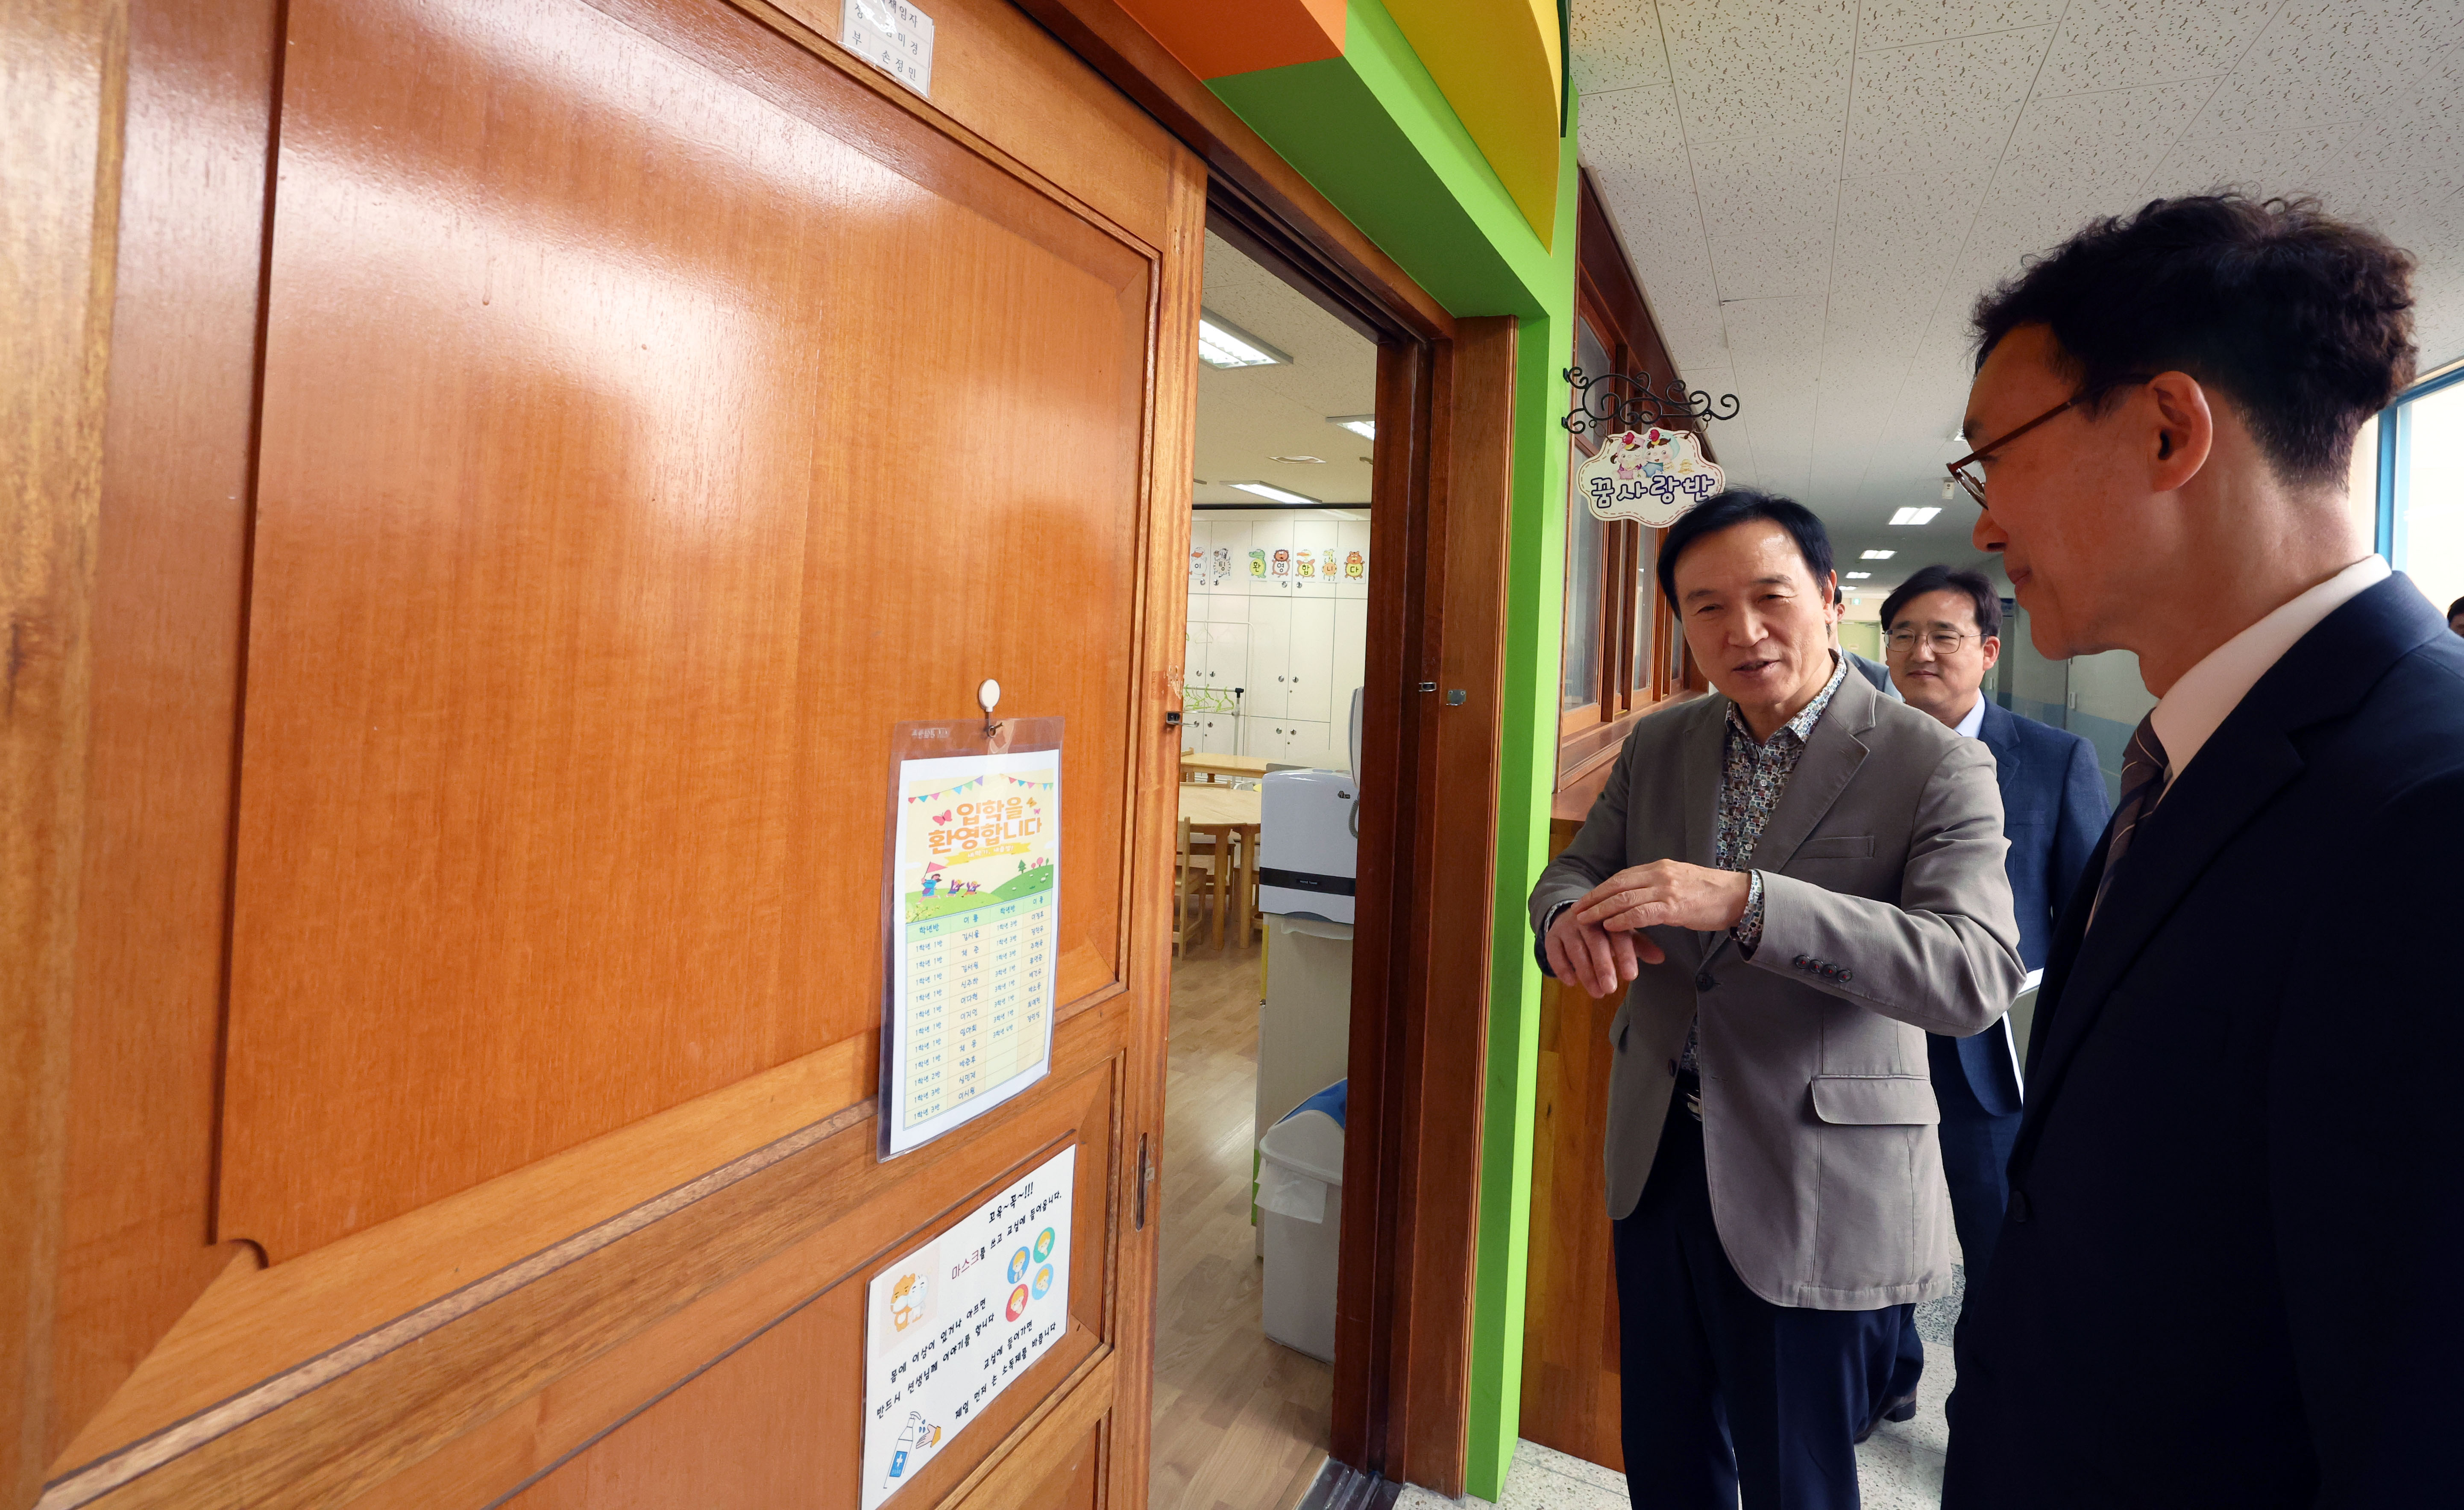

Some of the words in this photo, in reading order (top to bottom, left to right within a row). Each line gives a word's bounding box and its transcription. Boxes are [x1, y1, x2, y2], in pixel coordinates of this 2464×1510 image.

[852, 30, 862, 45] 부
[957, 796, 1023, 826] 입학을
[928, 817, 1042, 855] 환영합니다
[919, 923, 939, 934] 학년반
[1000, 905, 1015, 914] 학년반
[916, 942, 930, 952] 1학년
[934, 940, 943, 948] 1반
[916, 959, 930, 969] 1학년
[934, 956, 943, 964] 1반
[916, 975, 930, 985] 1학년
[934, 972, 942, 981] 1반
[916, 992, 930, 1002] 1학년
[916, 1008, 930, 1018] 1학년
[915, 1026, 930, 1036] 1학년
[915, 1043, 930, 1052] 1학년
[915, 1059, 929, 1069] 1학년
[933, 1055, 941, 1063] 1반
[915, 1076, 929, 1086] 1학년
[932, 1071, 940, 1079] 2반
[914, 1092, 929, 1103] 1학년
[931, 1087, 940, 1097] 3반
[914, 1109, 929, 1119] 1학년
[931, 1104, 940, 1113] 3반
[952, 1247, 985, 1280] 마스크를
[990, 1234, 1002, 1249] 쓰고
[1007, 1216, 1025, 1236] 교실에
[1030, 1191, 1062, 1221] 들어옵니다.
[891, 1362, 906, 1384] 몸에
[912, 1340, 935, 1363] 이상이
[941, 1319, 962, 1344] 있거나
[966, 1298, 986, 1319] 아프면
[984, 1345, 1003, 1369] 교실에
[1007, 1319, 1033, 1348] 들어가면
[877, 1391, 901, 1419] 반드시
[907, 1361, 938, 1394] 선생님께
[943, 1334, 970, 1362] 이야기를
[975, 1313, 994, 1337] 합니다
[955, 1401, 969, 1420] 제일
[974, 1384, 987, 1403] 먼저
[991, 1374, 997, 1387] 손
[1002, 1347, 1027, 1375] 소독제를
[1032, 1322, 1056, 1348] 바릅니다
